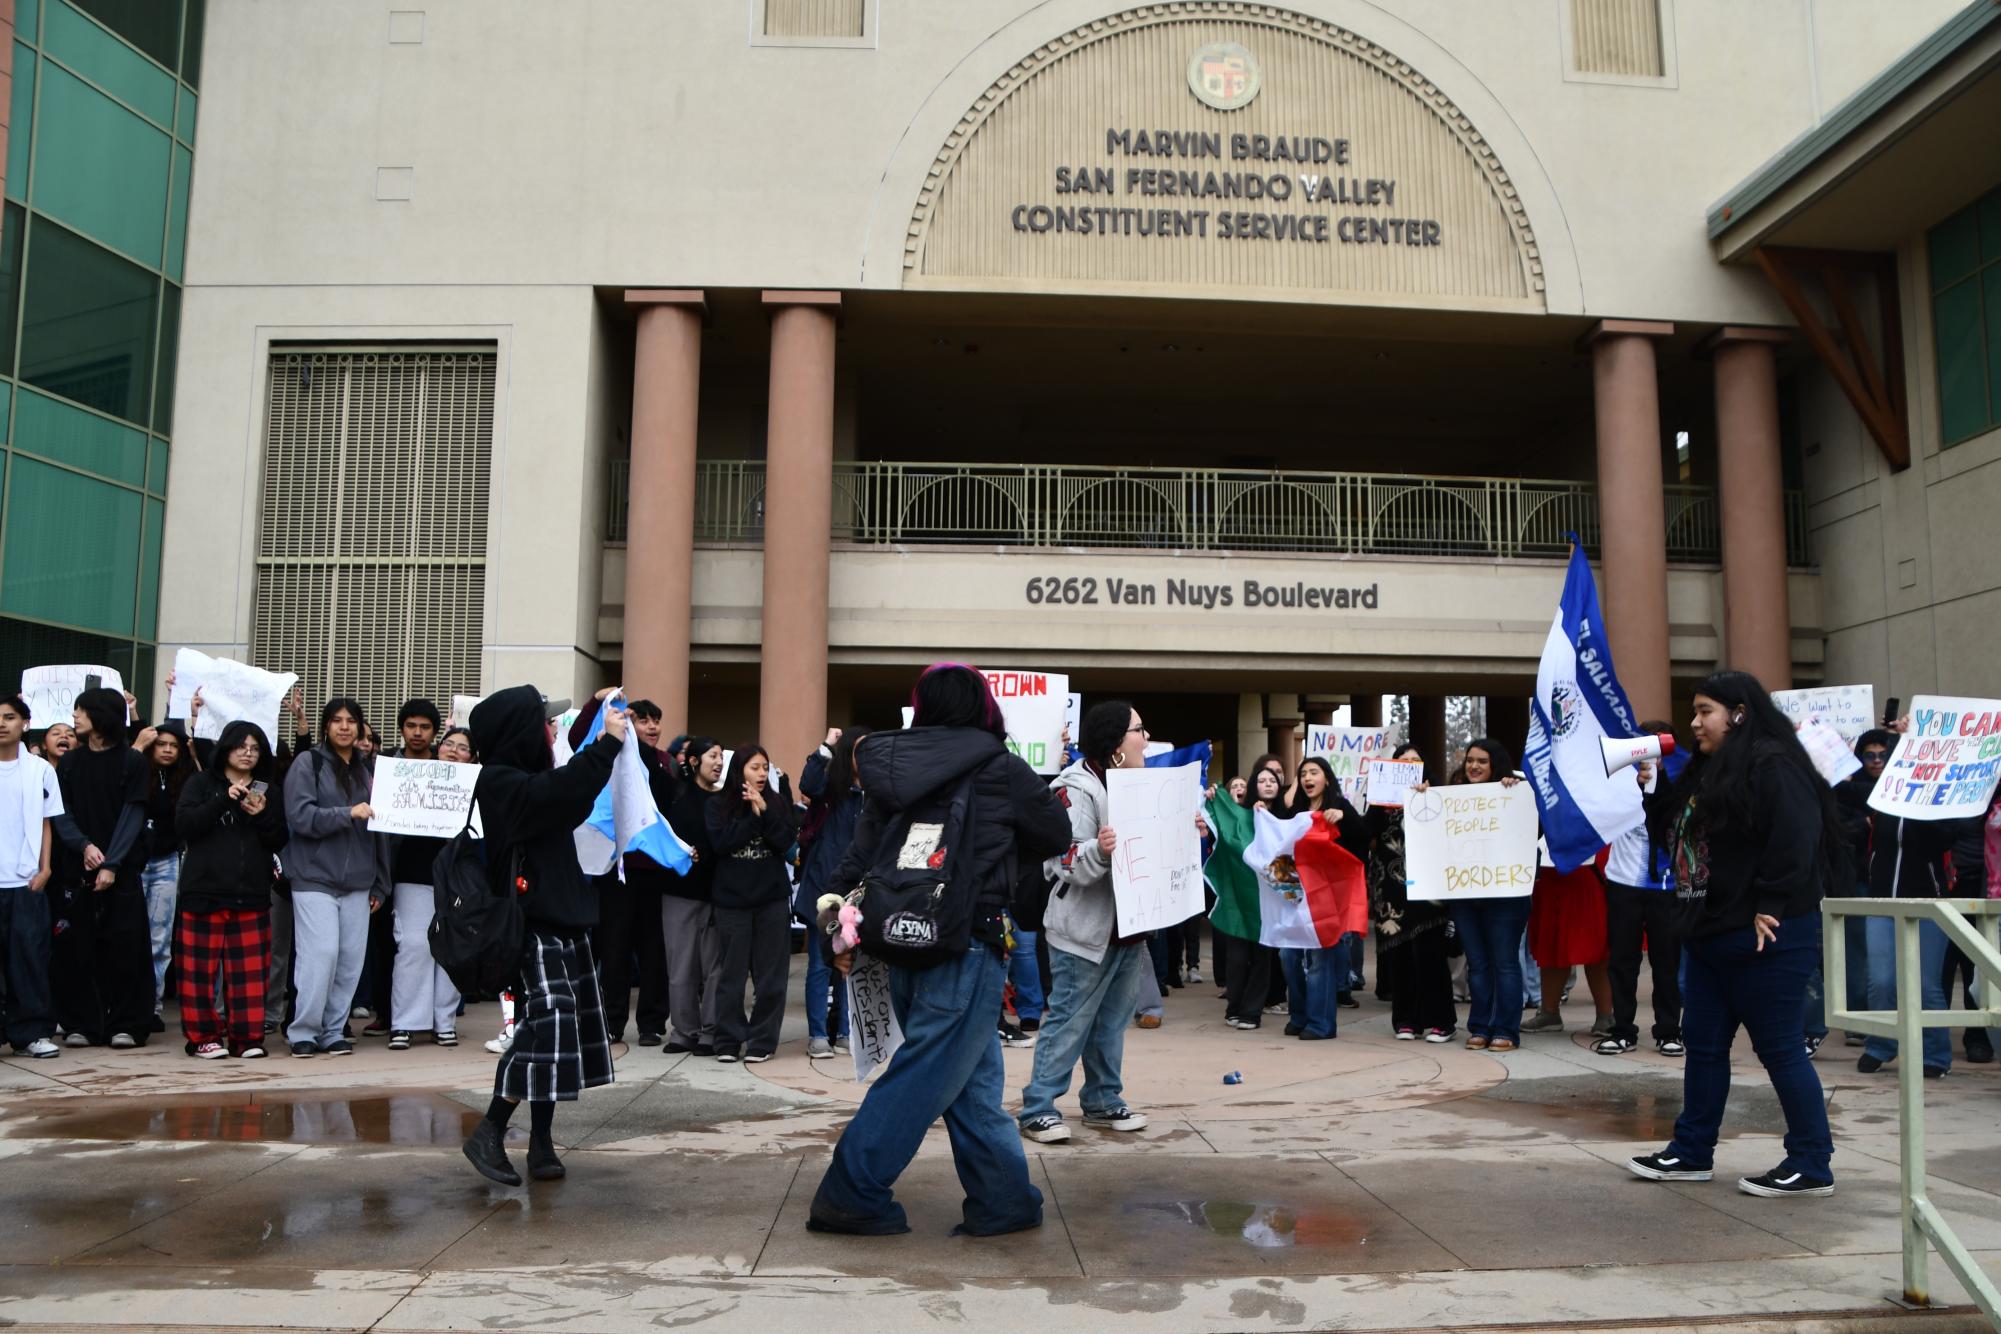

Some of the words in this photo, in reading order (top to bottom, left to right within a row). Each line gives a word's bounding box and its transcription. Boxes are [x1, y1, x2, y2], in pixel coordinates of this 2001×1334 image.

[1106, 128, 1221, 160] MARVIN
[1231, 133, 1350, 166] BRAUDE
[1055, 166, 1115, 196] SAN
[1126, 168, 1292, 202] FERNANDO
[1299, 174, 1397, 207] VALLEY
[1011, 205, 1210, 238] CONSTITUENT
[1217, 211, 1330, 244] SERVICE
[1337, 216, 1441, 248] CENTER
[1026, 577, 1098, 605] 6262
[1106, 578, 1156, 605] Van
[1166, 579, 1234, 610] Nuys
[1243, 581, 1379, 609] Boulevard
[1916, 709, 1958, 737] YOU
[1313, 731, 1336, 752] NO
[1340, 731, 1390, 753] MORE
[1902, 738, 1965, 762] LOVE
[1911, 762, 1947, 782] NOT
[1444, 796, 1513, 817] PROTECT
[1904, 782, 1952, 806] THE
[1445, 816, 1500, 837] PEOPLE
[1444, 864, 1534, 892] BORDERS
